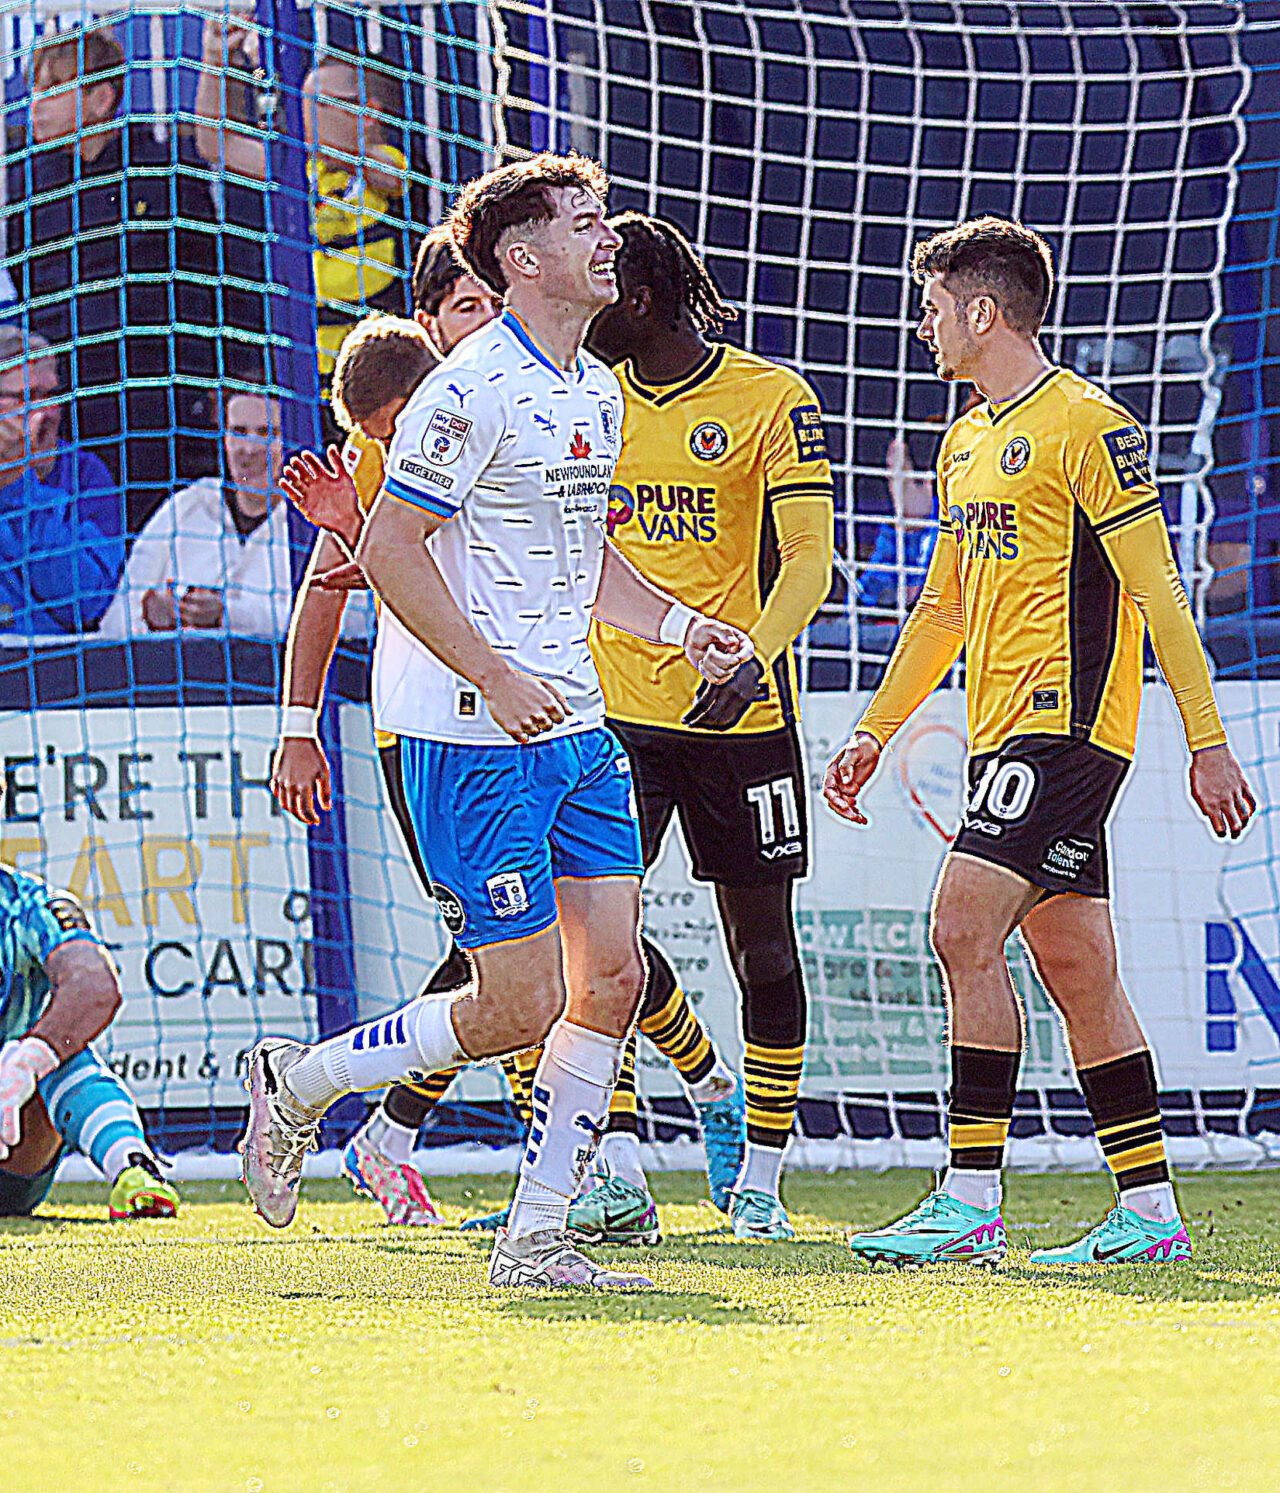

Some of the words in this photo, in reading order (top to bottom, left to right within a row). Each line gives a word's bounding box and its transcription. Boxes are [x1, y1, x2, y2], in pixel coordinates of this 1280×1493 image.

[430, 451, 444, 462] EFL
[952, 450, 971, 463] VX3
[401, 460, 453, 489] TOGETHER
[636, 484, 716, 514] PURE
[637, 513, 717, 542] VANS
[966, 502, 1018, 531] PURE
[746, 777, 801, 845] 11
[961, 815, 1002, 836] VX3
[761, 841, 802, 859] VX3
